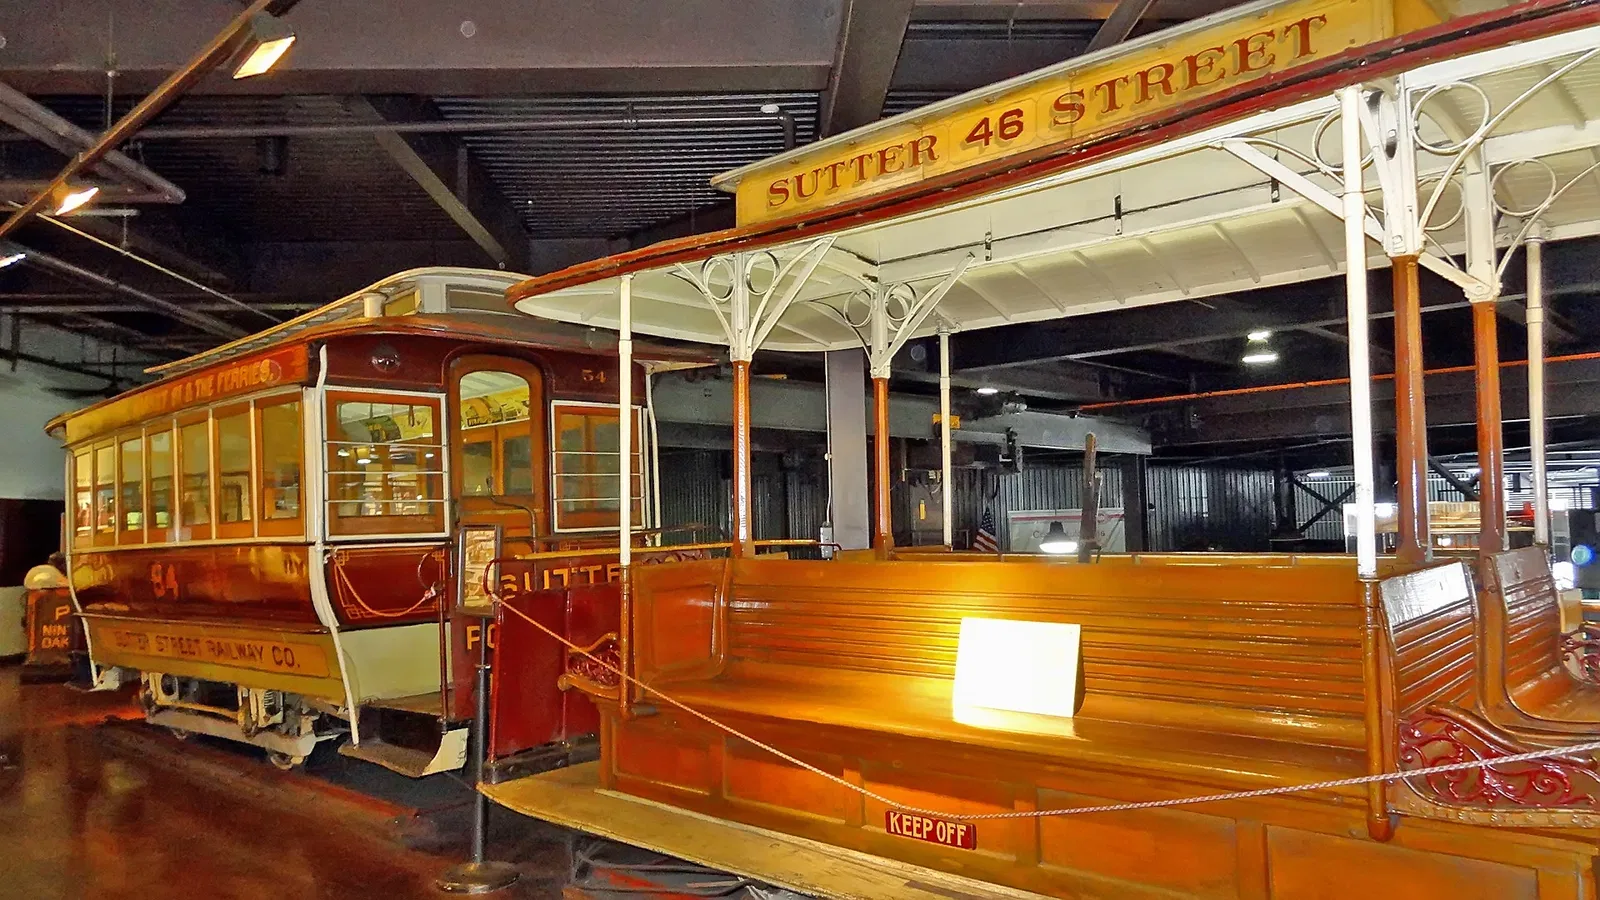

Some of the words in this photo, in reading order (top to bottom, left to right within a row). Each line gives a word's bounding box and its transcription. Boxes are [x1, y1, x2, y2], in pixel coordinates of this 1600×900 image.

[768, 134, 940, 207] SUTTER
[964, 107, 1025, 148] 46
[1052, 13, 1328, 126] STREET
[581, 368, 607, 384] 54
[155, 634, 200, 657] STREET
[205, 639, 264, 664] RAILWAY
[271, 644, 301, 669] CO.
[889, 811, 934, 840] KEEP
[936, 820, 967, 847] OFF
